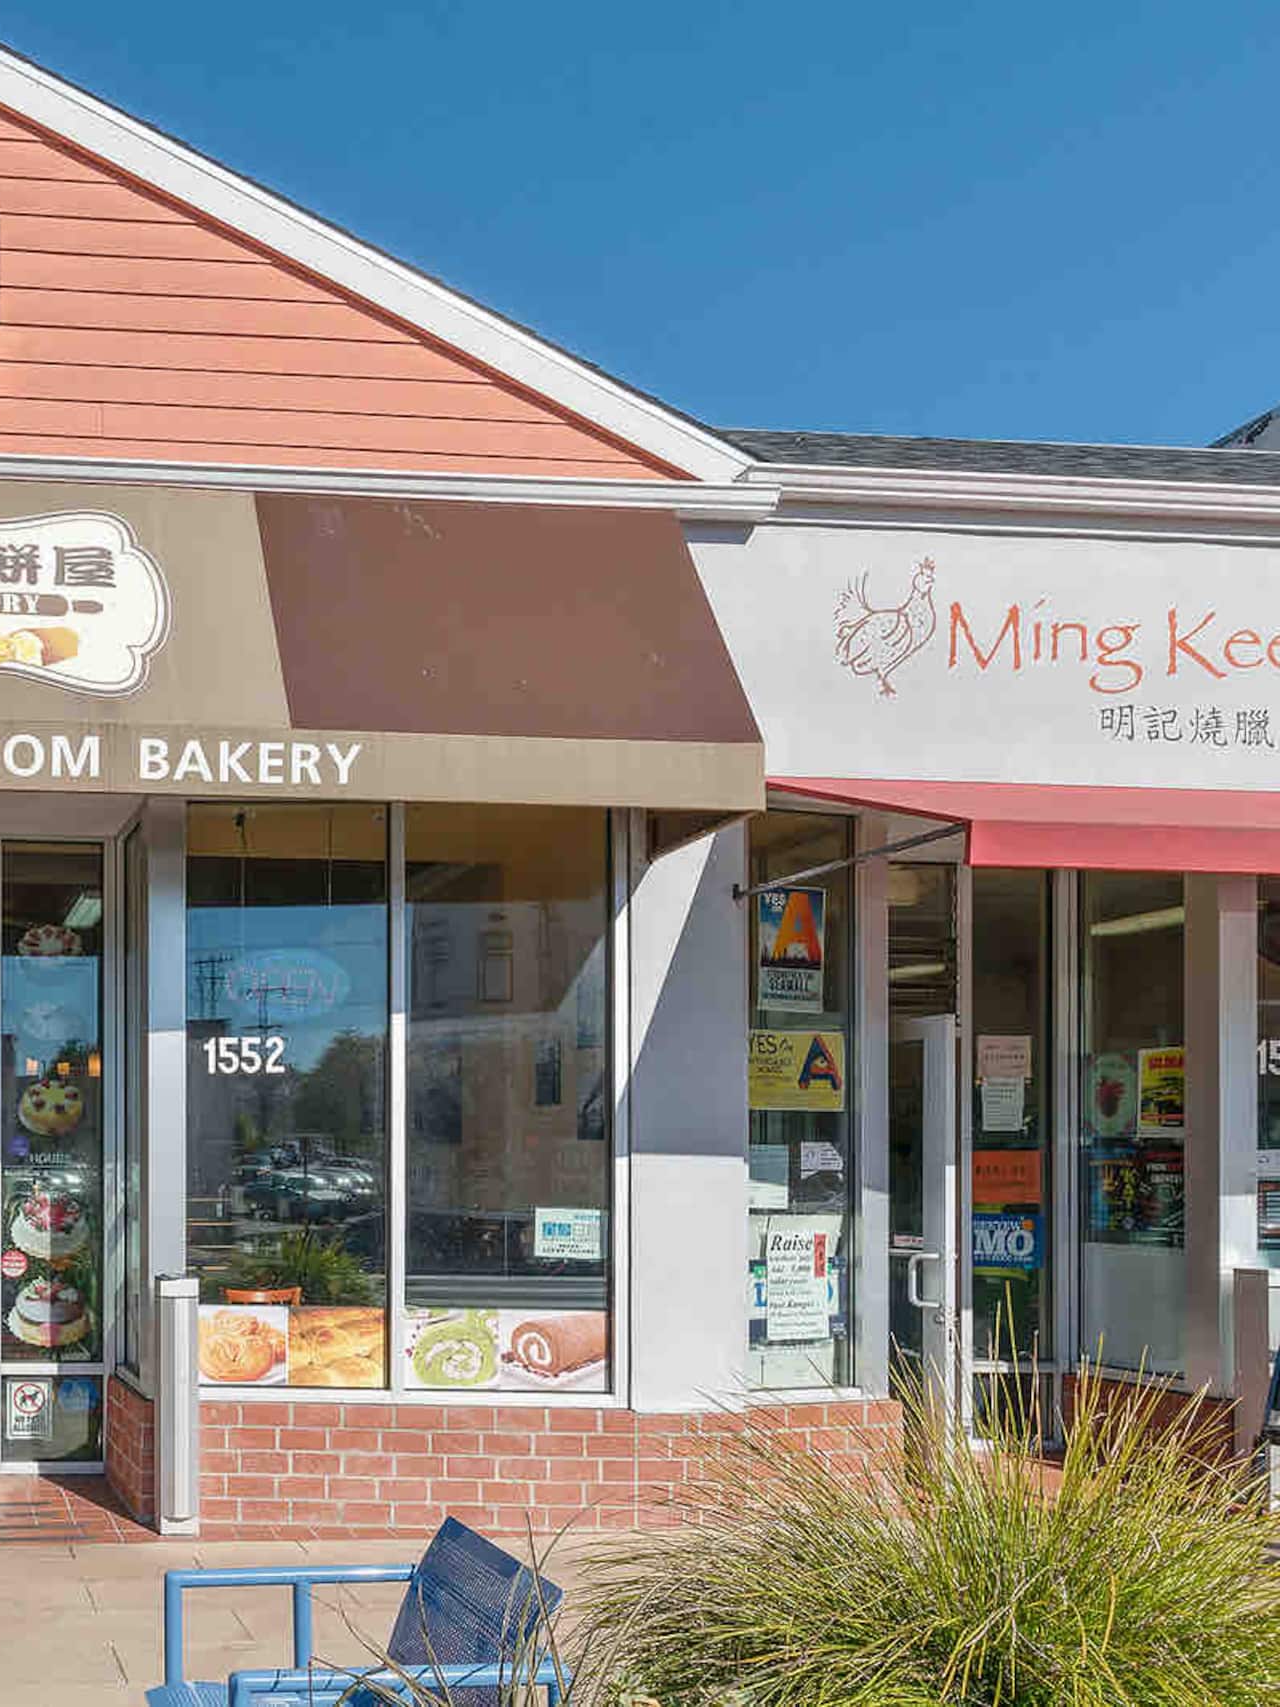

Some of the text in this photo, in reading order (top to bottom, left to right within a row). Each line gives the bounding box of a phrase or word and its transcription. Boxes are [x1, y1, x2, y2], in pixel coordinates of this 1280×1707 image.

[1100, 704, 1276, 748] 明記燒臘
[138, 738, 363, 785] BAKERY
[772, 891, 822, 961] A
[203, 1036, 285, 1075] 1552
[798, 1035, 843, 1091] A
[770, 1233, 813, 1251] Raise
